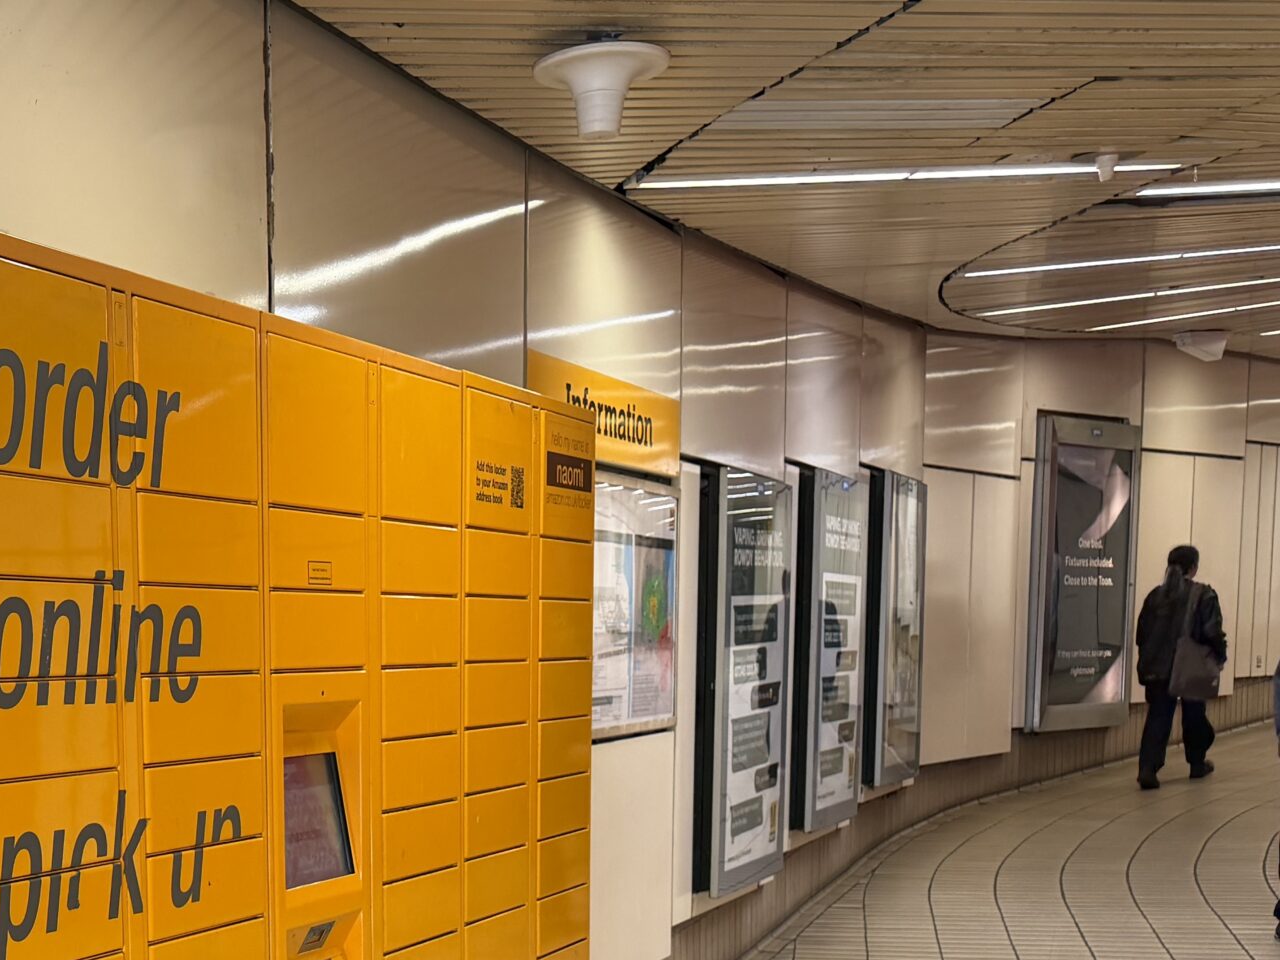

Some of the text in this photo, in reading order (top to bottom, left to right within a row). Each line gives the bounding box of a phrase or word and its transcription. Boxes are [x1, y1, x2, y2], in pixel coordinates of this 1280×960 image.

[494, 464, 506, 476] locker
[557, 463, 584, 488] naomi
[493, 492, 503, 504] book
[1064, 575, 1080, 586] Close
[1081, 576, 1088, 586] to
[1088, 576, 1097, 587] the
